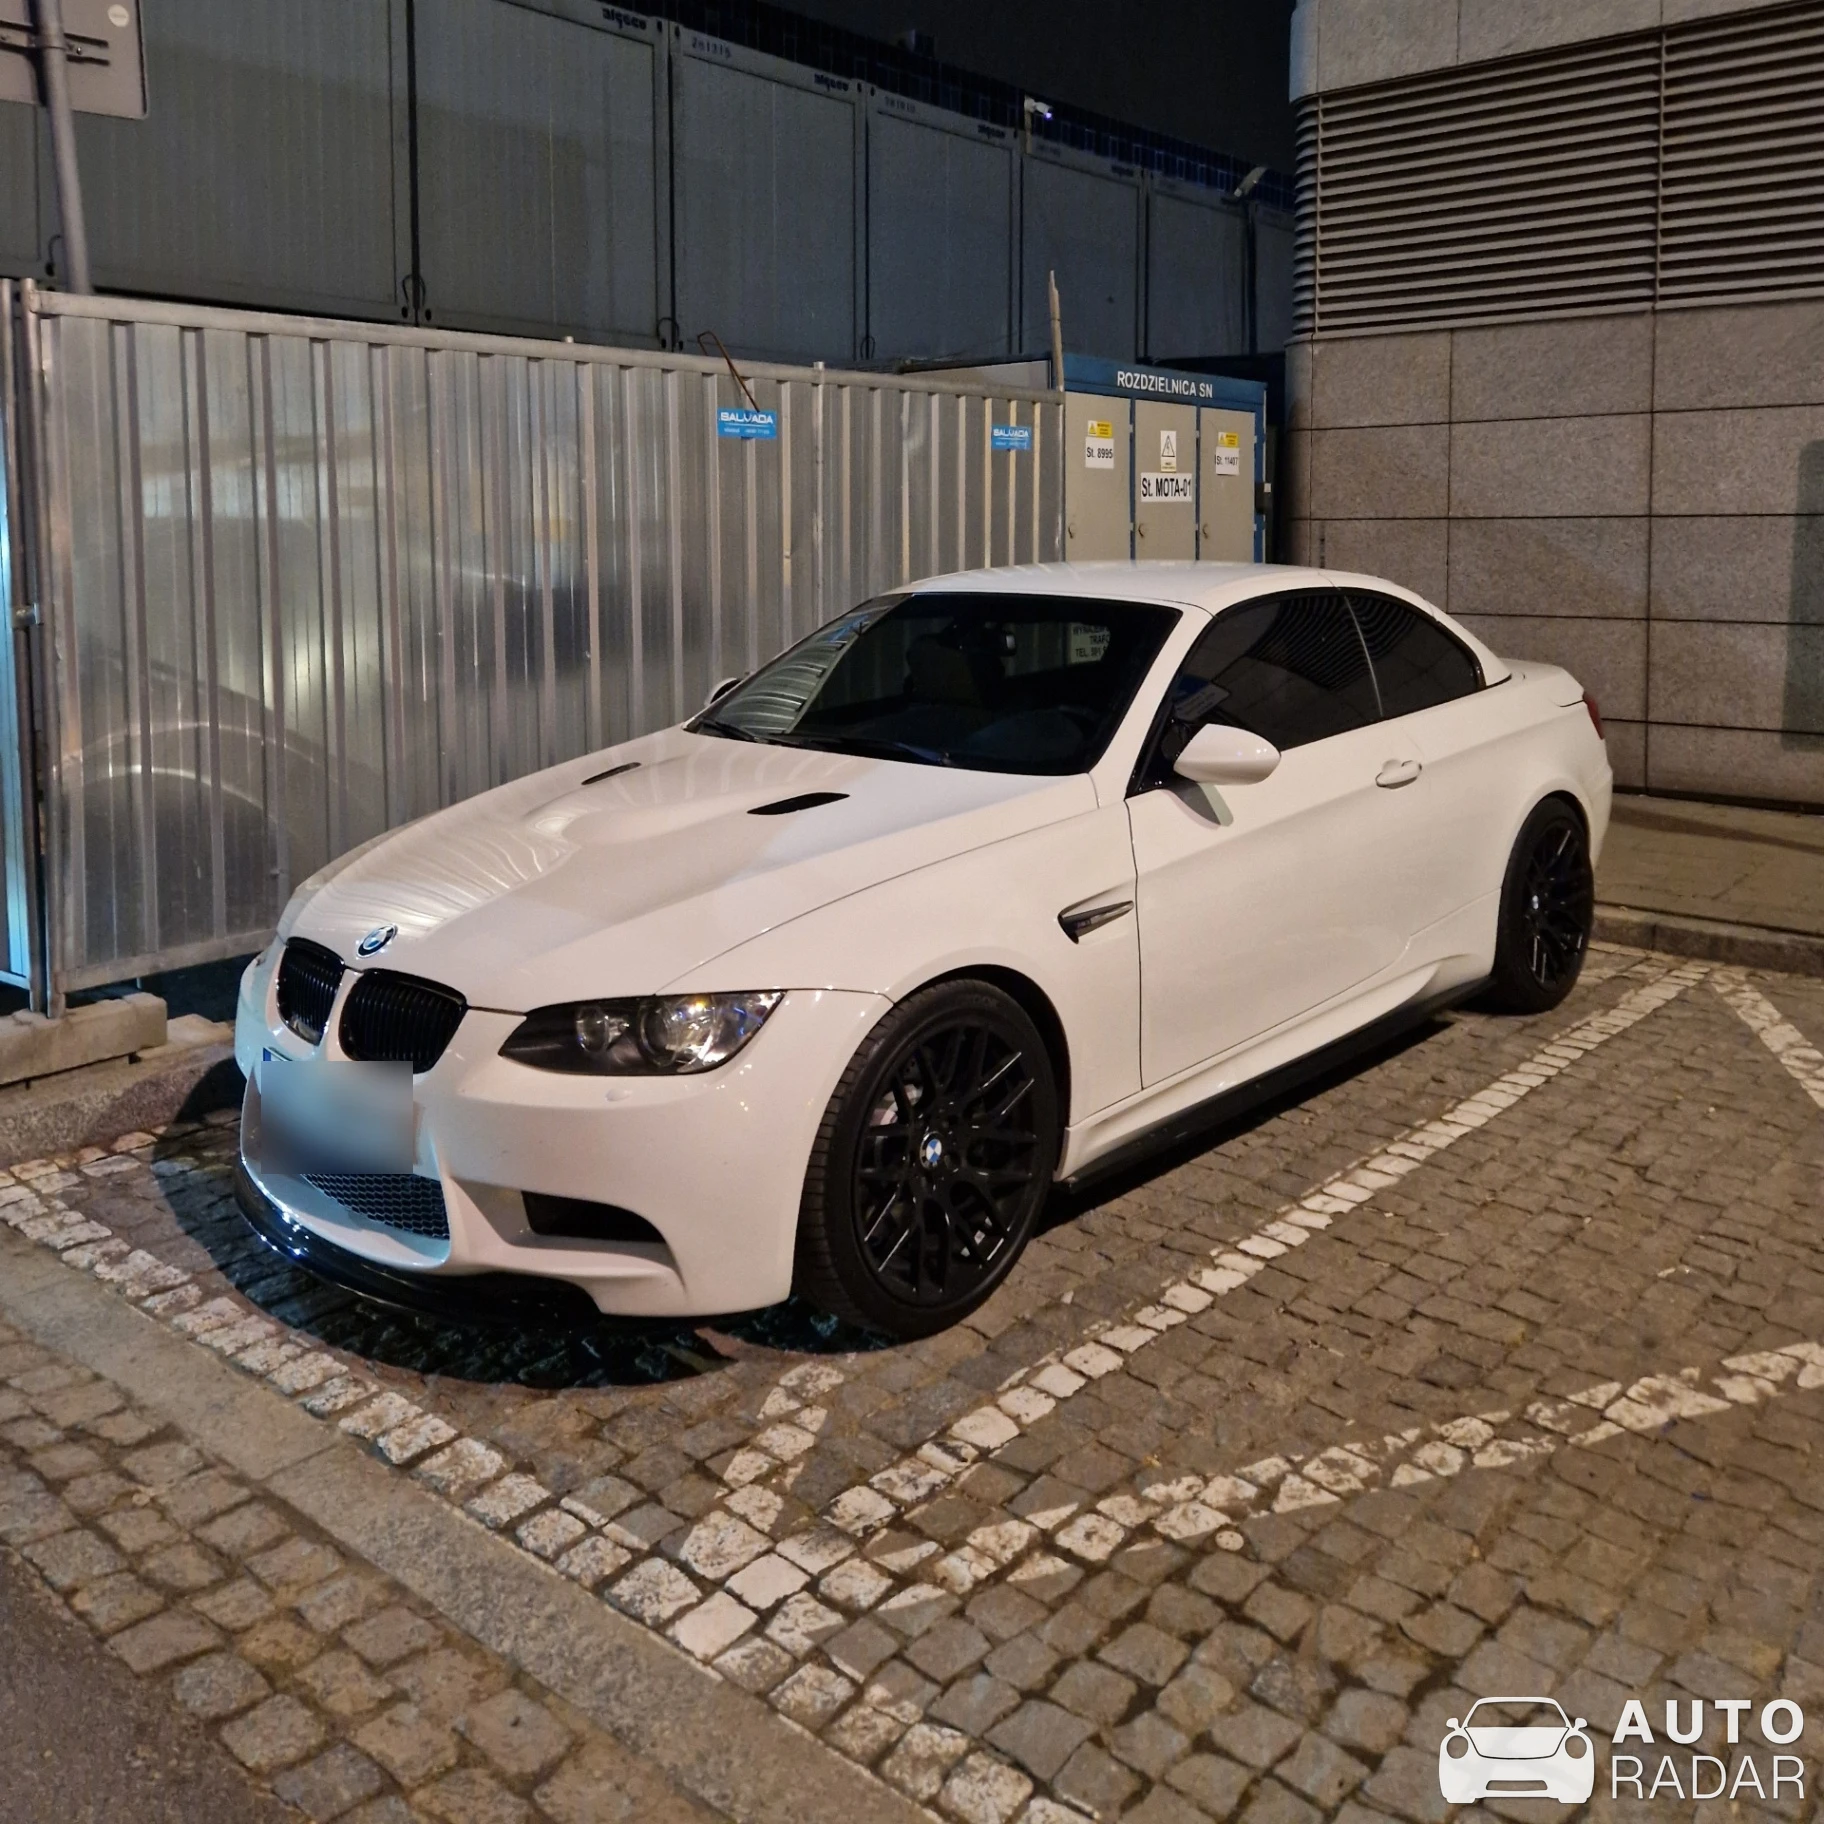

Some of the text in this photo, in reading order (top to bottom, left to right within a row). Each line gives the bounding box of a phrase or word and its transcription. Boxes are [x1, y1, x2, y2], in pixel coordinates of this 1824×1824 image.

[1117, 371, 1213, 398] ROZDZIELNICA SN
[1086, 447, 1113, 459] St. 8995
[1141, 477, 1192, 497] St. MOTA-01
